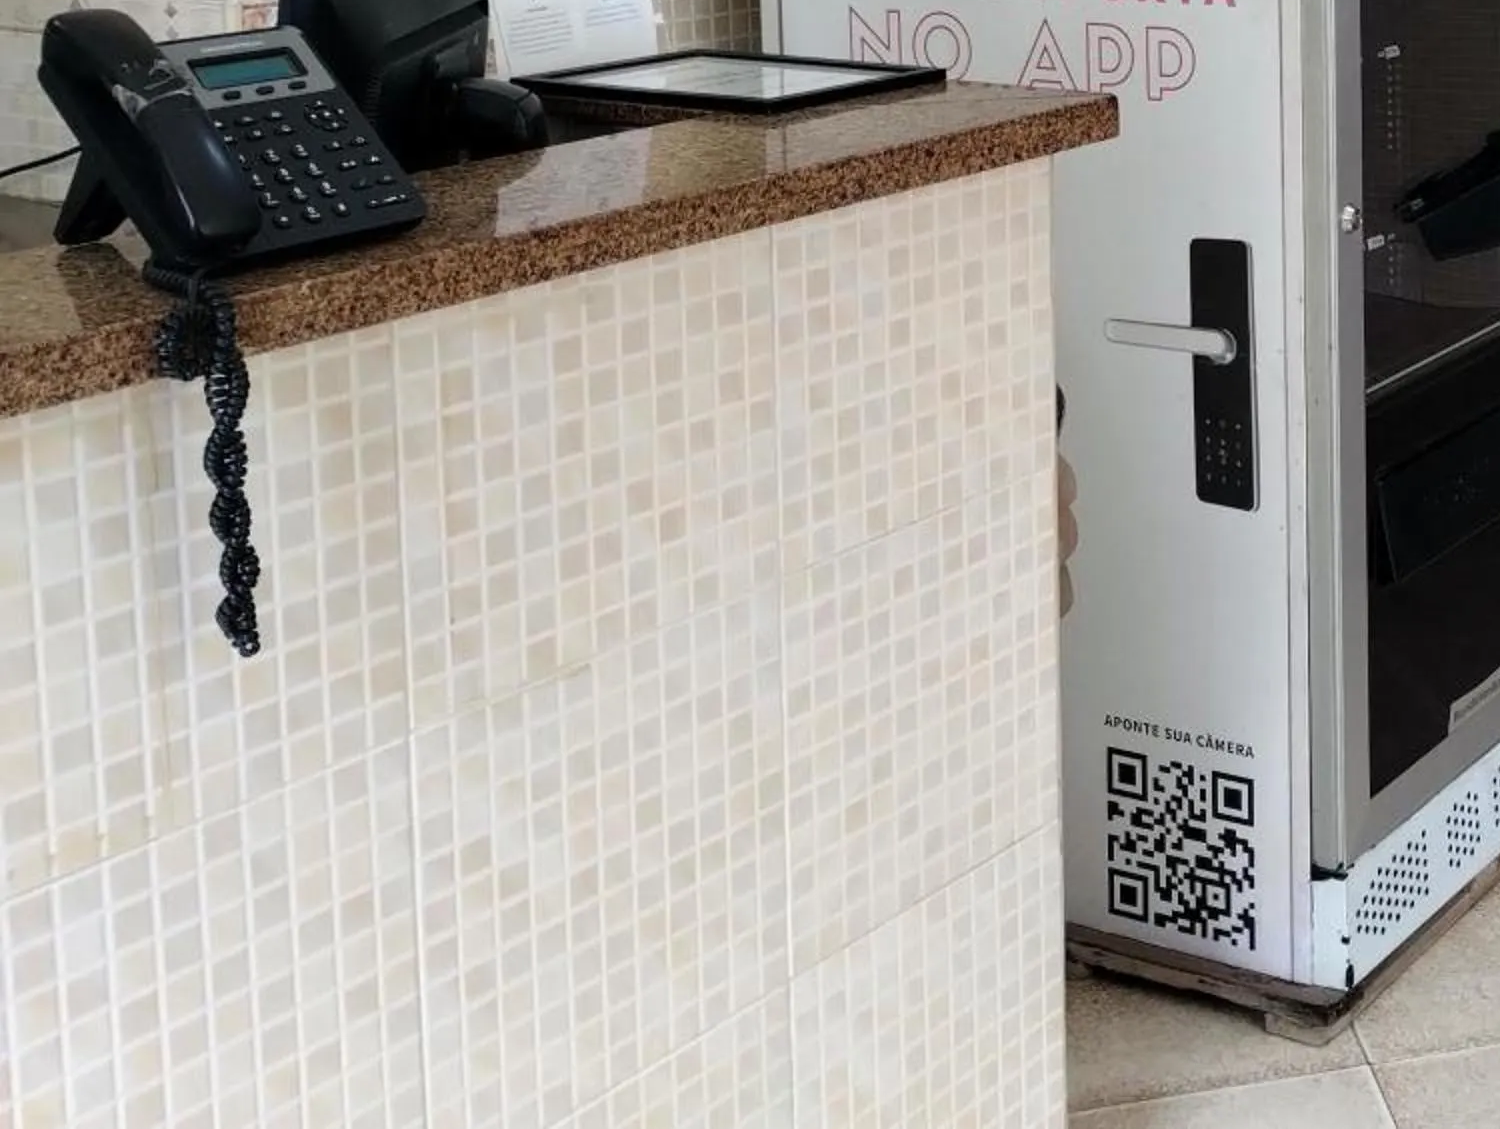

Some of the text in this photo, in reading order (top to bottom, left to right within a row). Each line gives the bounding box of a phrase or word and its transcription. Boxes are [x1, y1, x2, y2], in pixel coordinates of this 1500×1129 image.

[848, 6, 1197, 102] NO APP
[1104, 713, 1255, 758] APONTE SUA CÂMERA
